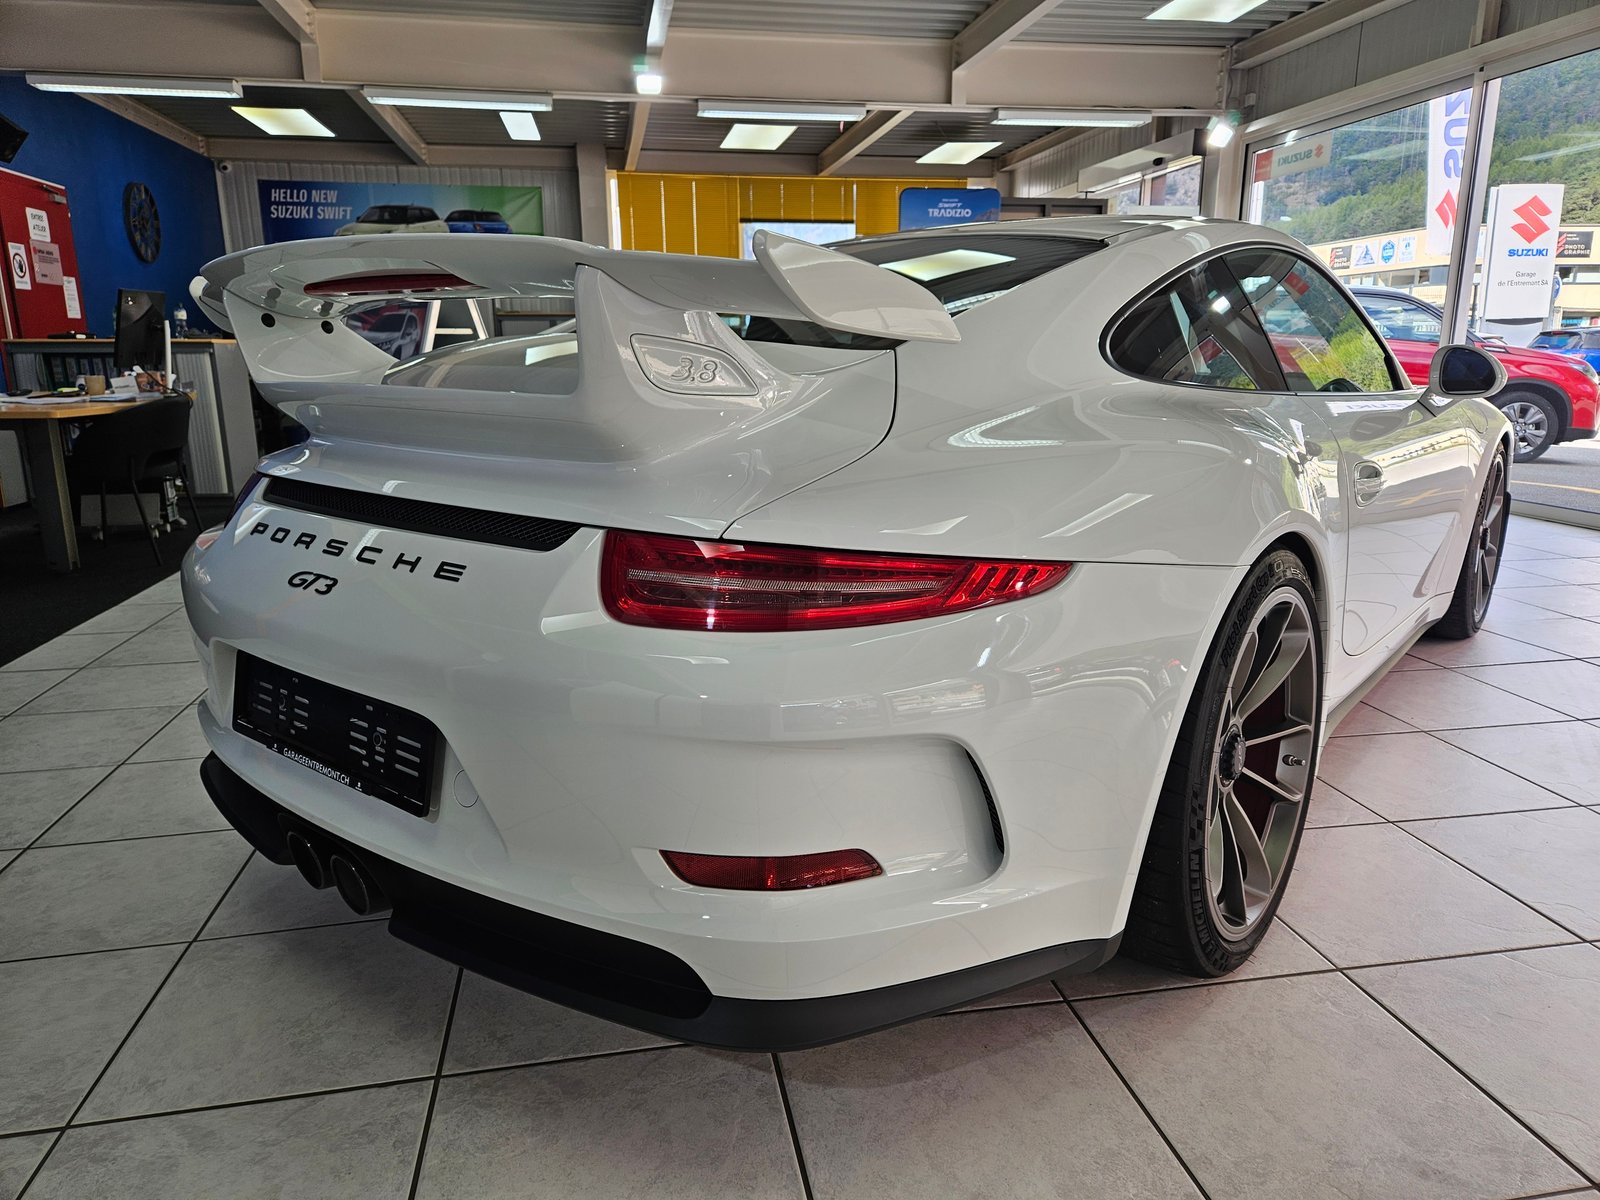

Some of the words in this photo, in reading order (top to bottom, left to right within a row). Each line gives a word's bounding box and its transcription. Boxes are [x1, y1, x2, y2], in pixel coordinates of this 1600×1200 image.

[271, 188, 307, 203] HELLO
[311, 189, 338, 203] NEW
[270, 204, 314, 219] SUZUKI
[317, 206, 353, 220] SWIFT
[928, 209, 972, 217] TRADIZIO
[1507, 248, 1549, 257] SUZUKI
[250, 521, 467, 583] PORSCHE
[287, 570, 339, 596] GT3
[283, 748, 350, 785] GARAGEENTREMONT.CH
[1190, 853, 1211, 945] MICHELIN
